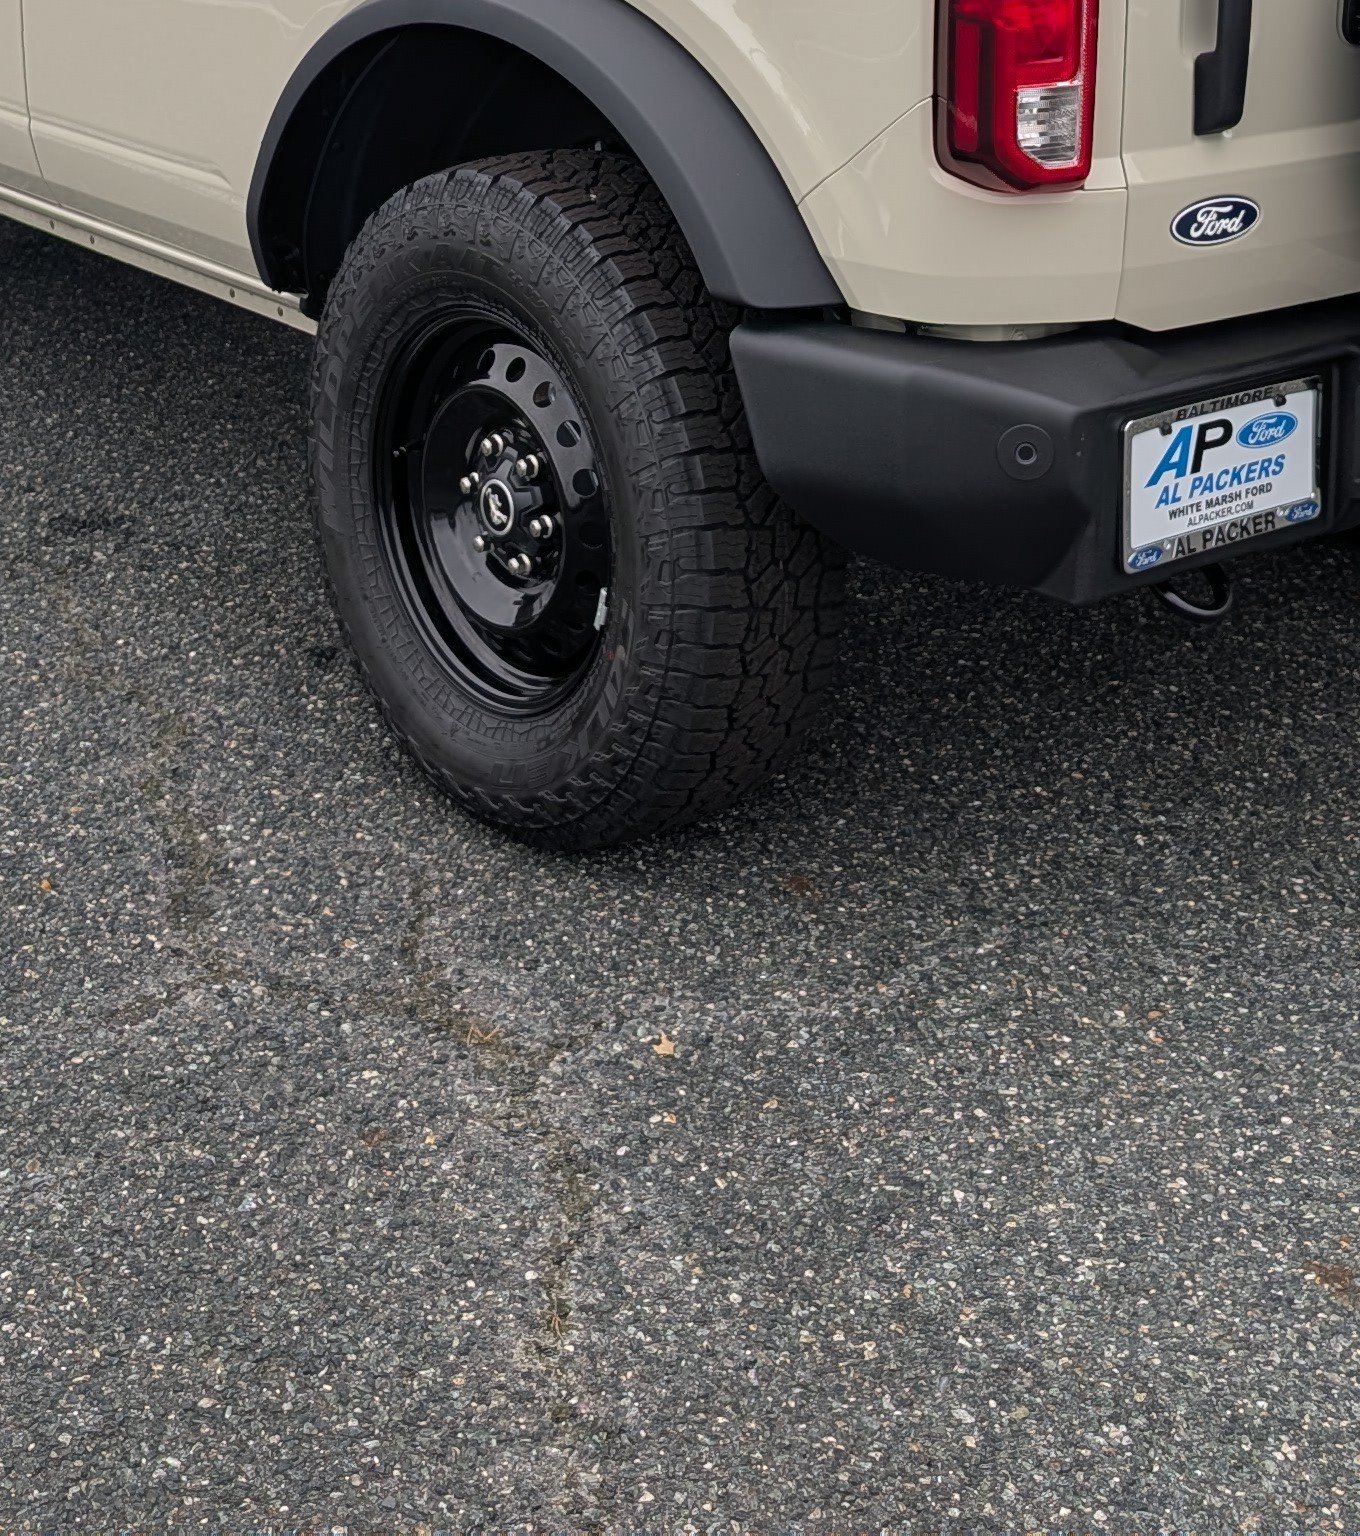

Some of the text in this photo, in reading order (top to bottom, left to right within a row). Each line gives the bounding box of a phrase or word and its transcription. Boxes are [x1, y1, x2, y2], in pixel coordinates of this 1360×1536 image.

[1190, 204, 1246, 238] Ford
[1175, 385, 1276, 419] BALTIMORE
[1248, 417, 1287, 444] Ford
[1144, 417, 1234, 489] AP
[1154, 453, 1286, 510] AL PACKERS
[1168, 482, 1273, 521] WHITE MARSH FORD
[1186, 500, 1254, 528] ALPACKER.COM
[1172, 511, 1277, 559] AL PACKER
